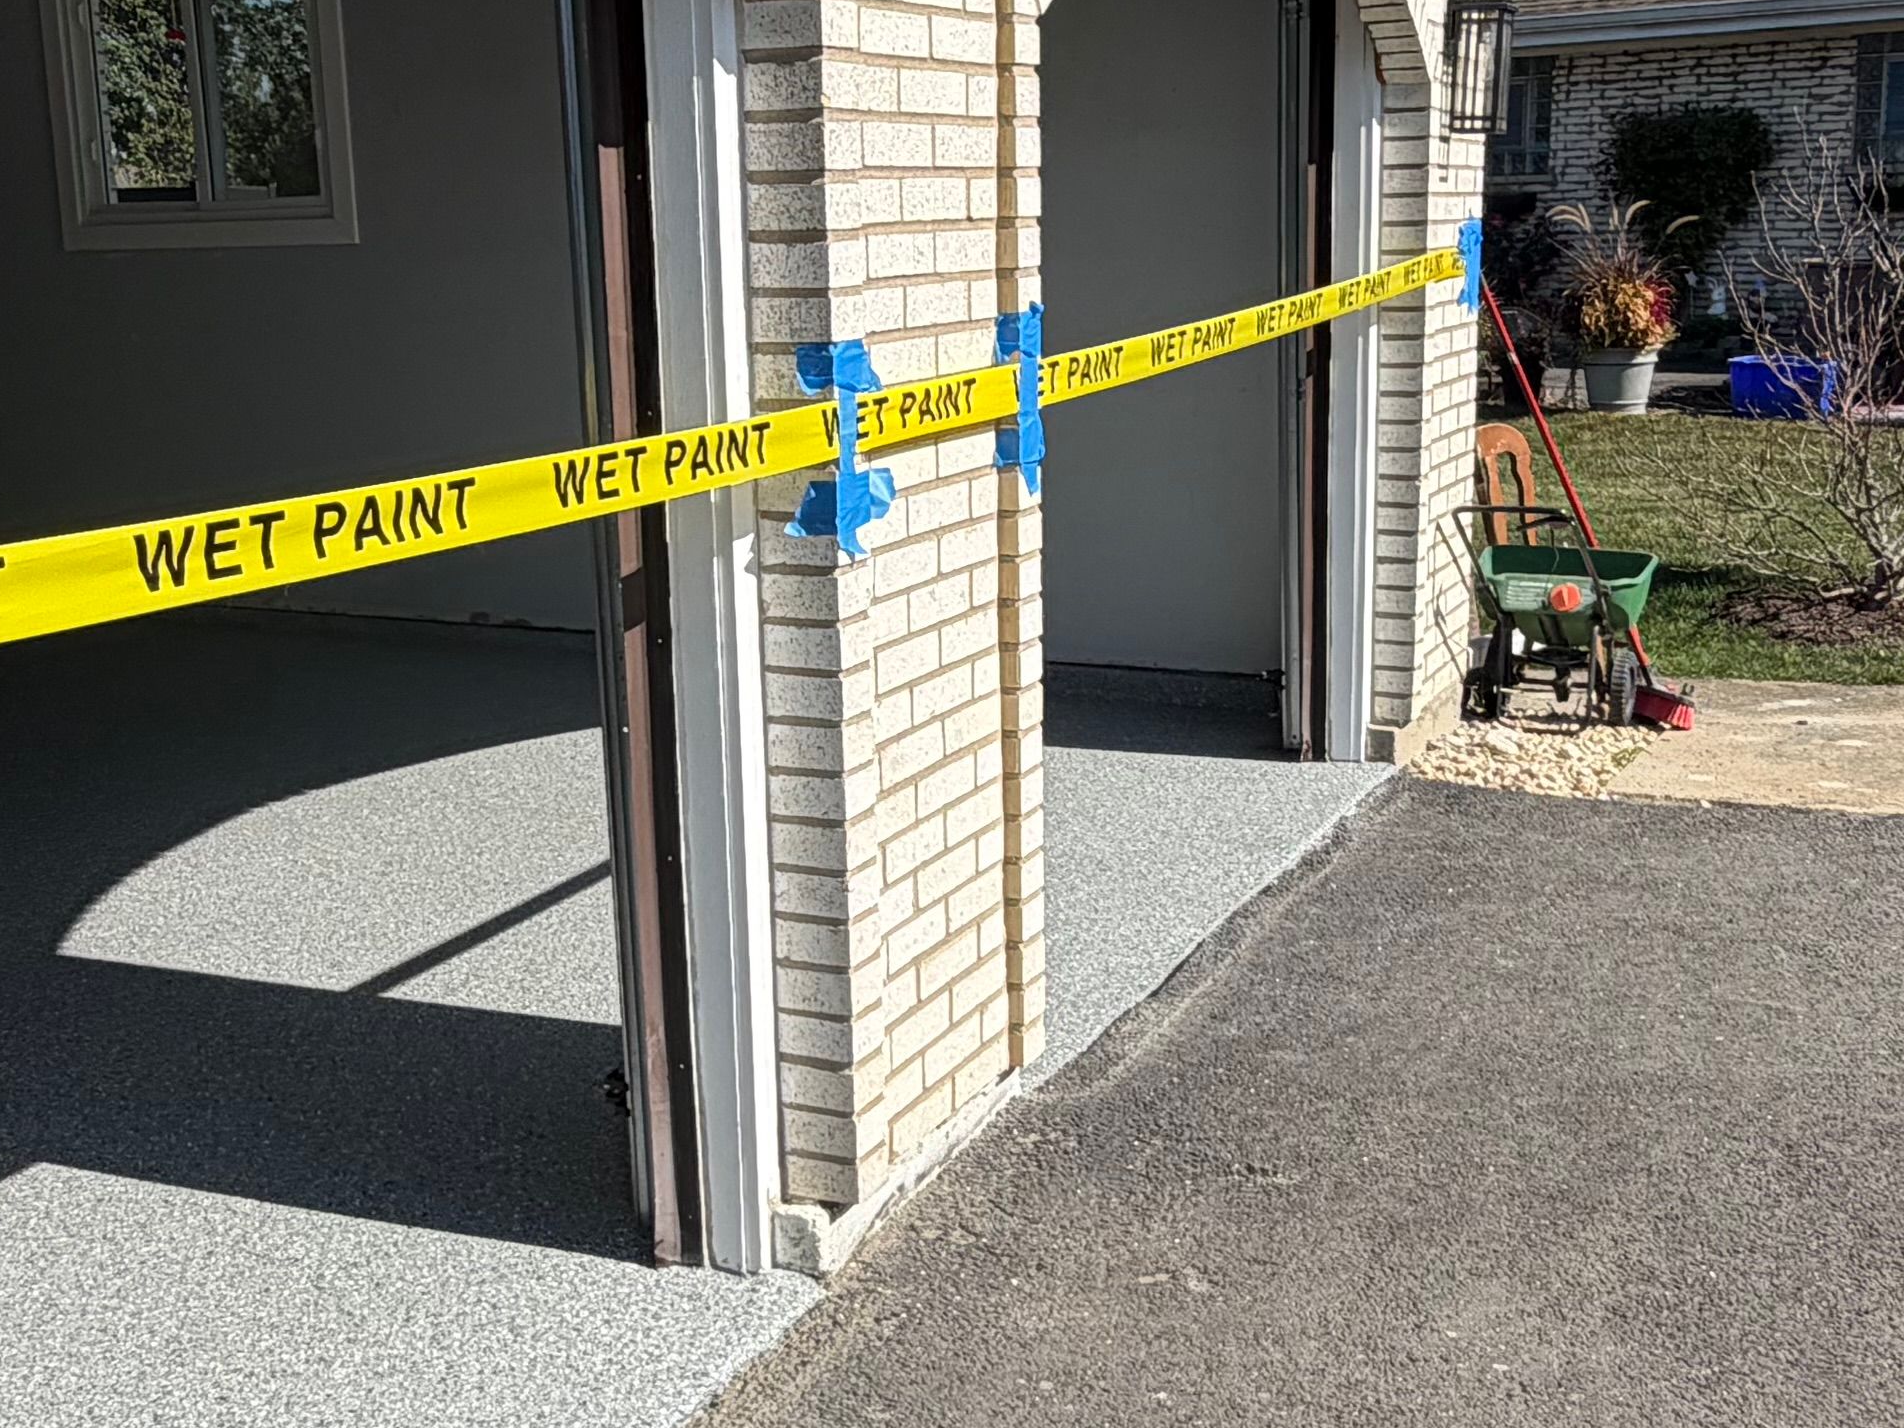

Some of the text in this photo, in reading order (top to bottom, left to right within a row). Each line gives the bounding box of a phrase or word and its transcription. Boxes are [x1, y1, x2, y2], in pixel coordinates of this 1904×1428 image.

[133, 511, 286, 592] WET
[314, 477, 475, 560] PAINT
[552, 446, 647, 509] WET
[664, 422, 770, 486] PAINT
[899, 377, 977, 429] PAINT
[1067, 346, 1124, 389] PAINT
[1150, 330, 1187, 368] WET
[1192, 317, 1236, 357] PAINT
[1255, 303, 1284, 337] WET
[1287, 292, 1323, 328] PAINT
[1338, 280, 1361, 310] WET
[1363, 271, 1391, 302] PAINT
